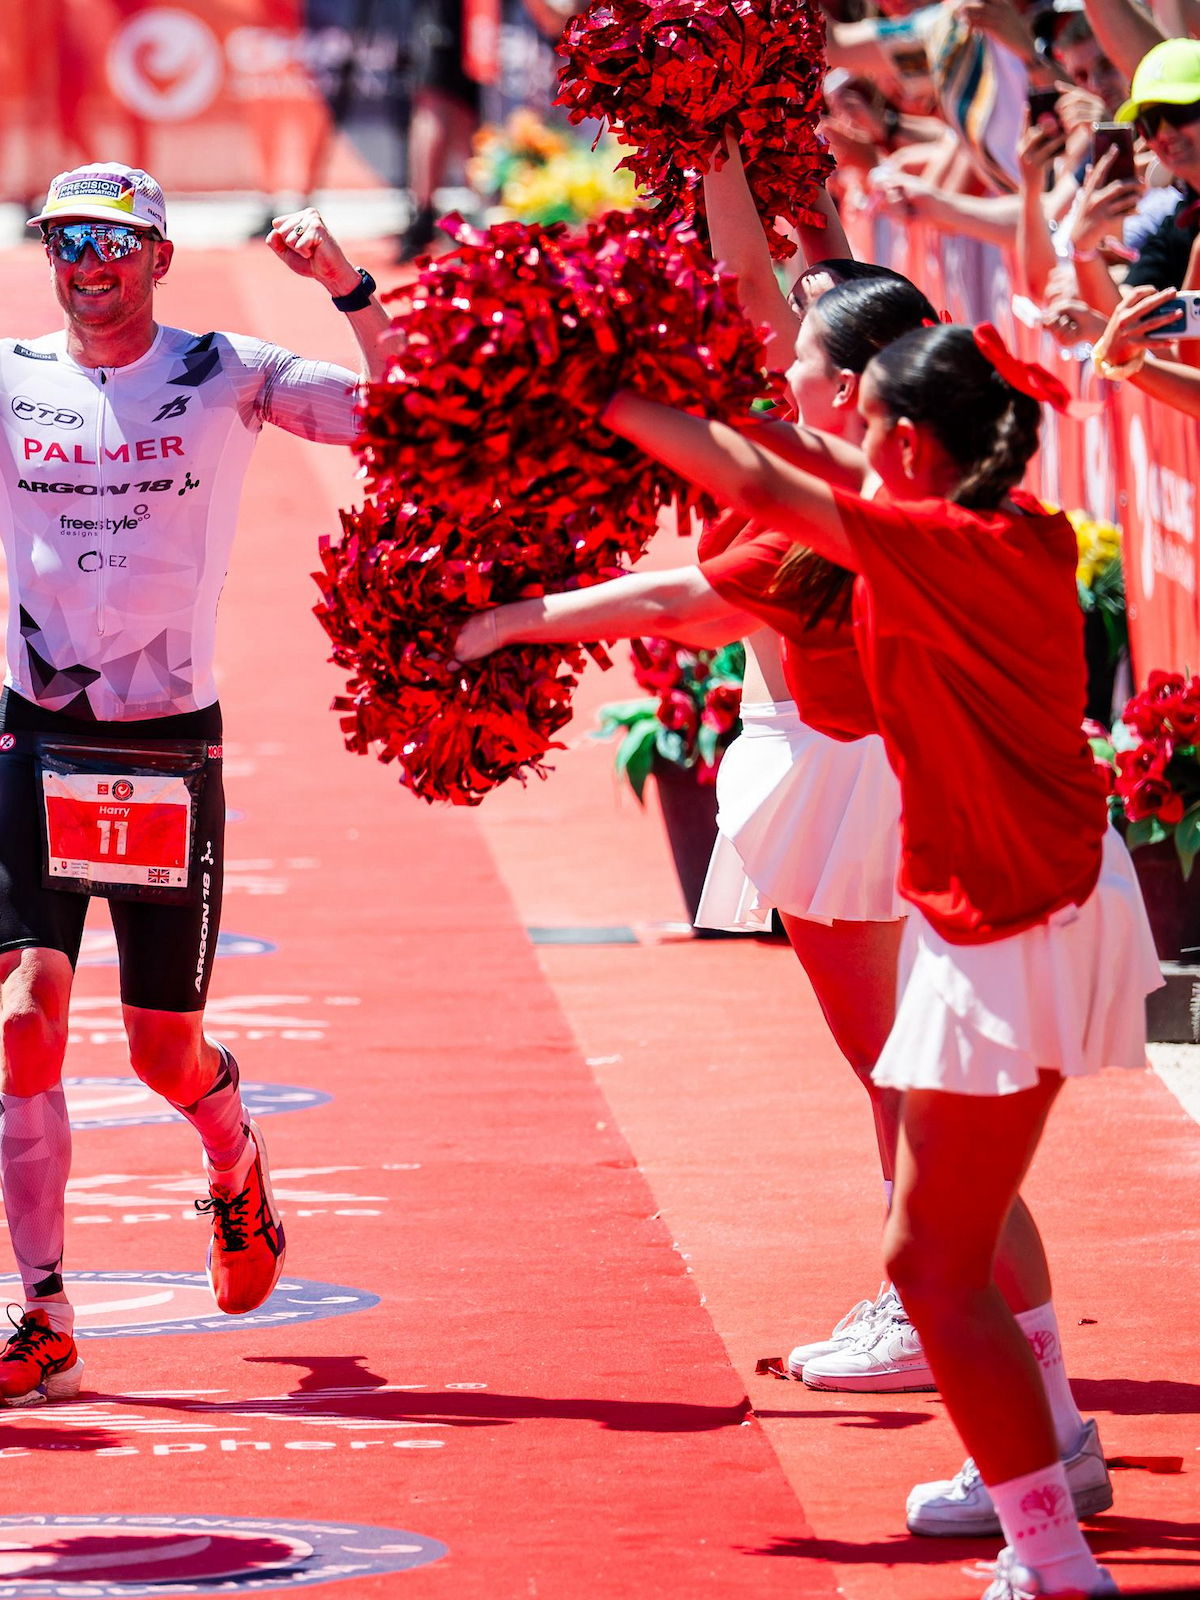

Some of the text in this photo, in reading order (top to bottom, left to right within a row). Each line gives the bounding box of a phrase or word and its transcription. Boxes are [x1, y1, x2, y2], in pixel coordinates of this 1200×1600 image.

[61, 181, 118, 193] PRECISION
[15, 401, 78, 424] PTO
[23, 435, 186, 465] PALMER
[17, 479, 174, 497] ARGON 18
[59, 514, 138, 535] freestyle
[60, 529, 98, 538] designs
[99, 805, 131, 817] Harry
[96, 819, 129, 856] 11
[195, 872, 211, 993] ARGON 18
[95, 1438, 446, 1456] sphere
